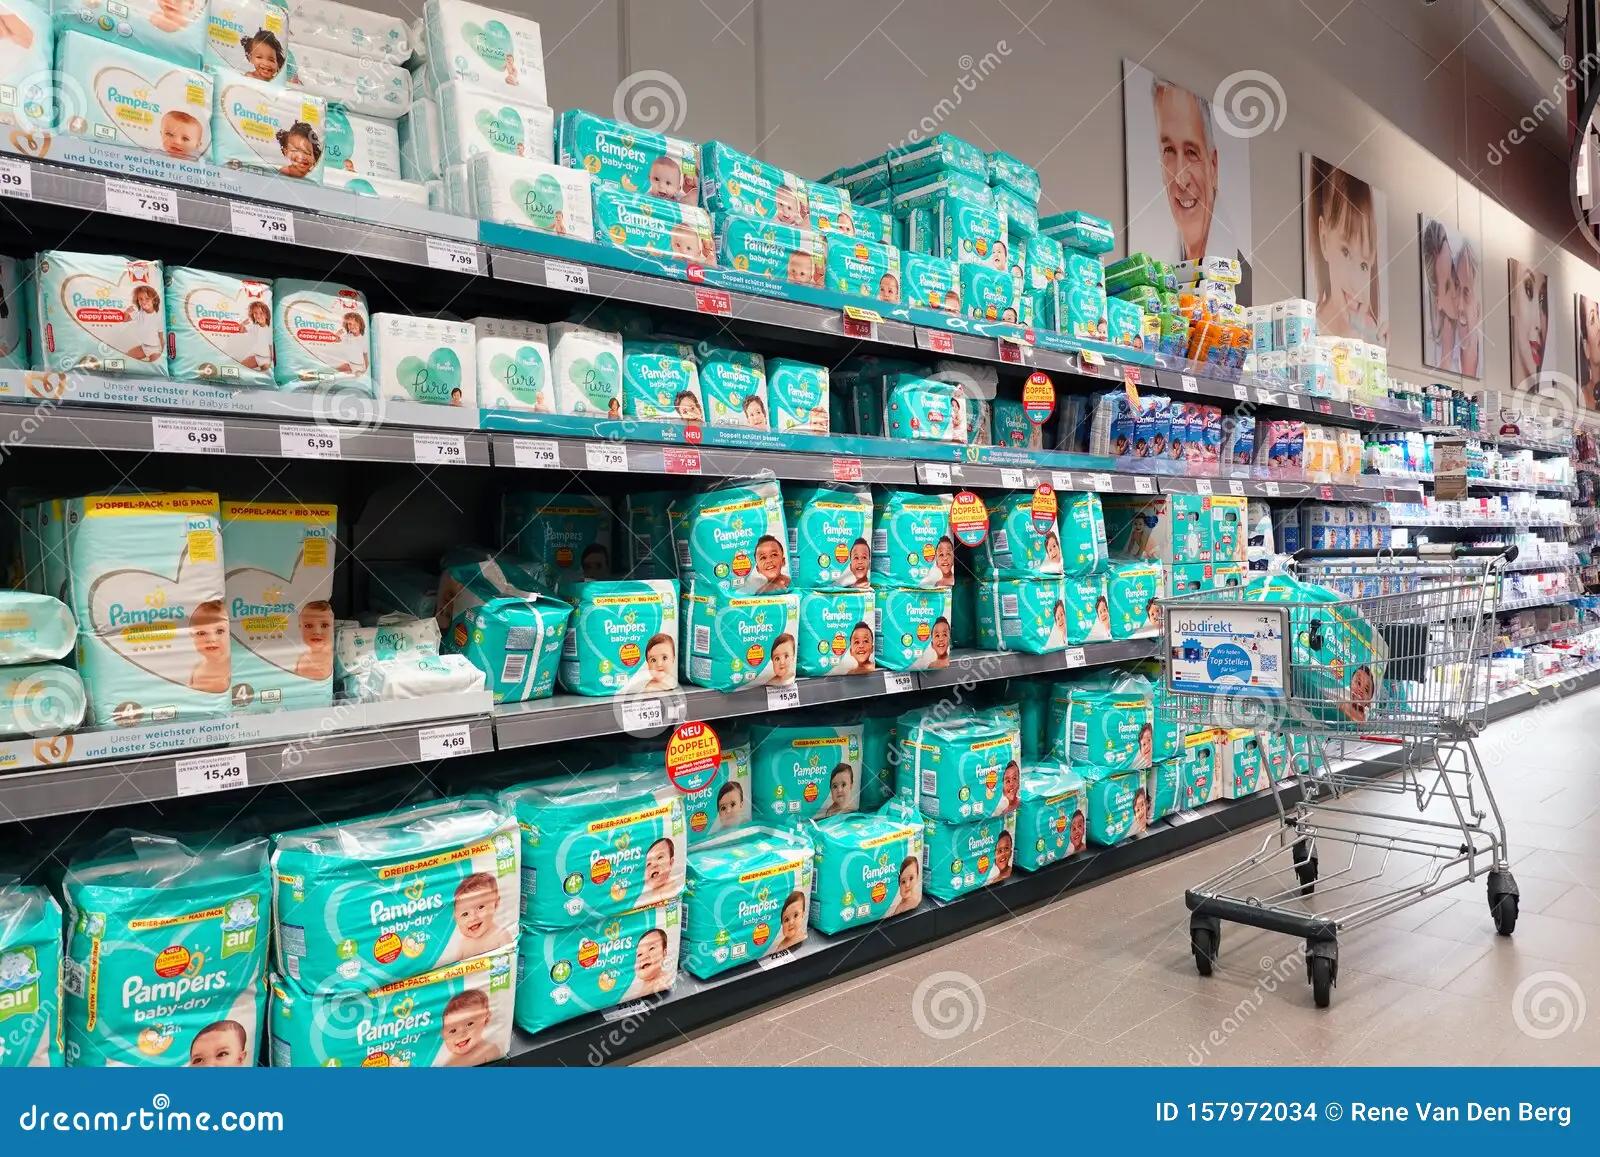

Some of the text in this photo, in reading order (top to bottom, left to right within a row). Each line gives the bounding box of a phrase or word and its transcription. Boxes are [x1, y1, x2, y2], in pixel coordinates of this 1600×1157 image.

[108, 87, 161, 114] Pampers
[234, 102, 279, 127] Pampers
[596, 134, 647, 165] Pampers
[89, 146, 221, 179] Unser weichster Komfort
[602, 156, 642, 174] baby-dry
[64, 152, 86, 163] und
[89, 156, 124, 172] bester
[128, 164, 165, 179] Schutz
[186, 174, 217, 189] Babys
[219, 182, 243, 193] Haut
[733, 161, 771, 190] Pampers
[138, 199, 170, 213] 7.99
[523, 190, 554, 215] Pure
[260, 219, 287, 232] 7,99
[617, 204, 667, 232] Pampers
[625, 224, 661, 240] baby-dry
[970, 220, 996, 238] Pampers
[744, 233, 785, 258] Pampers
[449, 253, 472, 265] 7.99
[749, 253, 779, 267] baby-dry
[845, 257, 876, 275] Pampers
[564, 274, 584, 285] 7.99
[721, 274, 744, 284] Doppelt
[745, 277, 765, 288] schützt
[765, 282, 784, 291] besser
[72, 292, 124, 310] Pampers
[711, 299, 728, 309] 7,55
[79, 312, 124, 322] nappy pants
[195, 304, 241, 320] Pampers
[294, 316, 336, 331] Pampers
[503, 363, 537, 388] Pure
[641, 364, 681, 380] Pampers
[717, 365, 751, 384] Pampers
[1032, 375, 1046, 384] NEU
[412, 368, 450, 396] Pure
[583, 369, 612, 394] Pure
[103, 381, 234, 400] Unser weichster Komfort
[787, 383, 815, 399] Pampers
[1025, 386, 1053, 395] DOPPELT
[79, 390, 100, 400] und
[103, 391, 138, 402] bester
[142, 394, 179, 406] Schutz
[199, 399, 230, 411] Babys
[188, 432, 218, 444] 6,99
[685, 431, 702, 439] NEU
[719, 431, 741, 440] Doppelt
[742, 432, 761, 441] schützt
[762, 434, 780, 442] besser
[308, 438, 334, 450] 6,99
[437, 446, 460, 456] 7.99
[534, 451, 555, 461] 7.99
[604, 454, 623, 465] 7,99
[680, 458, 697, 467] 7,55
[1039, 485, 1052, 494] NEU
[95, 498, 213, 510] DOPPEL-PACK BIG PACK
[959, 495, 975, 504] NEU
[1033, 496, 1056, 505] DOPPELT
[231, 507, 330, 517] DOPPEL-PACK BIG PACK
[952, 506, 984, 516] DOPPELT
[714, 527, 754, 543] Pampers
[823, 521, 853, 536] Pampers
[911, 522, 937, 537] Pampers
[721, 540, 749, 550] baby-dry
[1125, 587, 1149, 600] Pampers
[109, 603, 184, 627] Pampers
[232, 598, 294, 618] Pampers
[822, 608, 852, 622] Pampers
[906, 603, 934, 617] Pampers
[605, 620, 646, 634] Pampers
[738, 620, 772, 635] Pampers
[826, 622, 848, 630] baby-dry
[611, 634, 640, 642] baby-dry
[743, 634, 768, 643] baby-dry
[1209, 656, 1249, 667] Top Stellen
[779, 692, 798, 701] 15,99
[638, 710, 660, 720] 15,99
[110, 721, 240, 744] Unser weichster Komfort
[680, 725, 701, 739] NEU
[1118, 721, 1140, 734] Pampers
[86, 729, 261, 757] und bester Schutz für Babys Haut
[442, 736, 465, 749] 4,69
[669, 737, 715, 757] DOPPELT
[669, 747, 717, 764] SCHÜTZT BESSER
[203, 766, 241, 781] 15,49
[793, 762, 827, 777] Pampers
[591, 806, 669, 831] DREIER-PACK MAXI PACK
[968, 835, 995, 851] Pampers
[384, 844, 491, 878] DREIER-PACK MAXI PACK
[498, 857, 515, 871] air
[862, 863, 896, 881] Pampers
[370, 892, 443, 925] Pampers
[738, 899, 778, 918] Pampers
[131, 908, 224, 929] DREIER-PACK MAXI PACK
[380, 914, 434, 936] baby-dry
[743, 914, 772, 926] baby-dry
[225, 929, 250, 947] air
[371, 960, 486, 994] DREIER-PACK MAXI PACK
[491, 973, 510, 988] air
[123, 970, 227, 1009] Pampers
[133, 996, 212, 1024] baby-dry
[356, 1008, 431, 1045] Pampers
[367, 1033, 421, 1056] baby-dry
